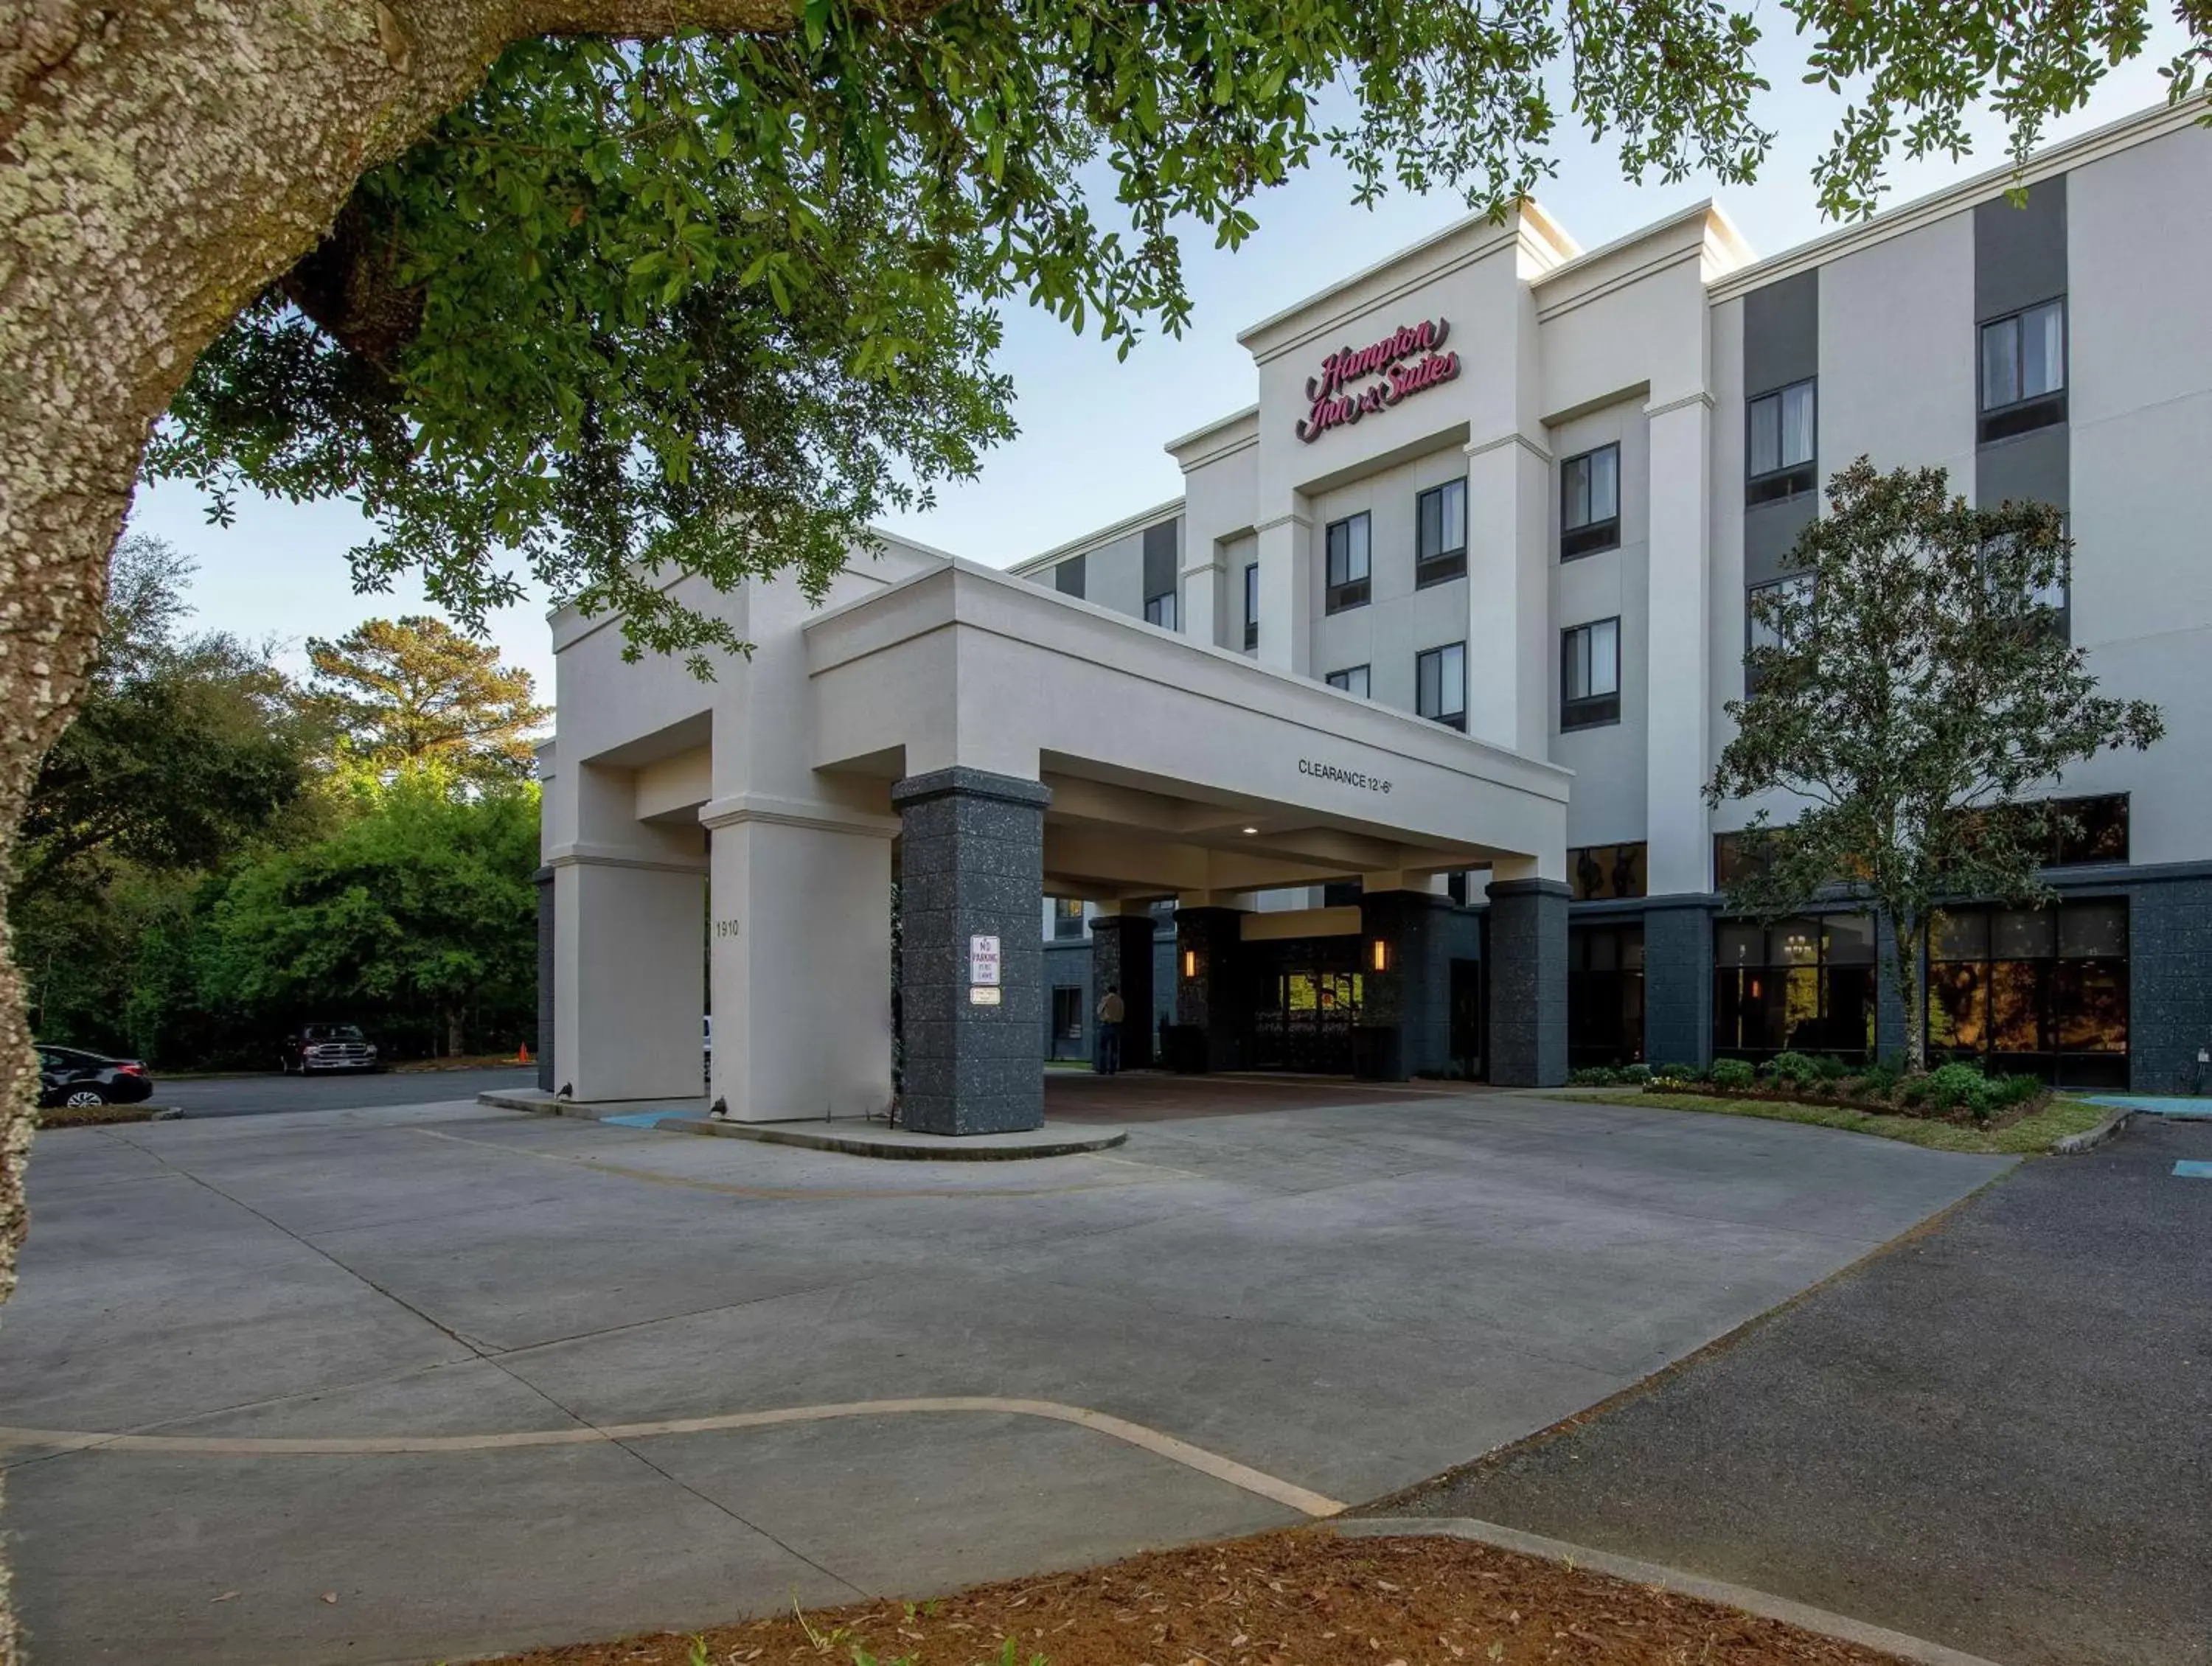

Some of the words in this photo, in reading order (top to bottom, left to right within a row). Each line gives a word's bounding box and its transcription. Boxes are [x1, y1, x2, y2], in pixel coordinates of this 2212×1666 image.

[1305, 316, 1450, 402] Hampton
[1295, 394, 1364, 443] Inn
[1377, 350, 1462, 406] Suites
[1298, 759, 1366, 788] CLEARANCE
[717, 919, 739, 938] 1910
[980, 941, 991, 952] NO
